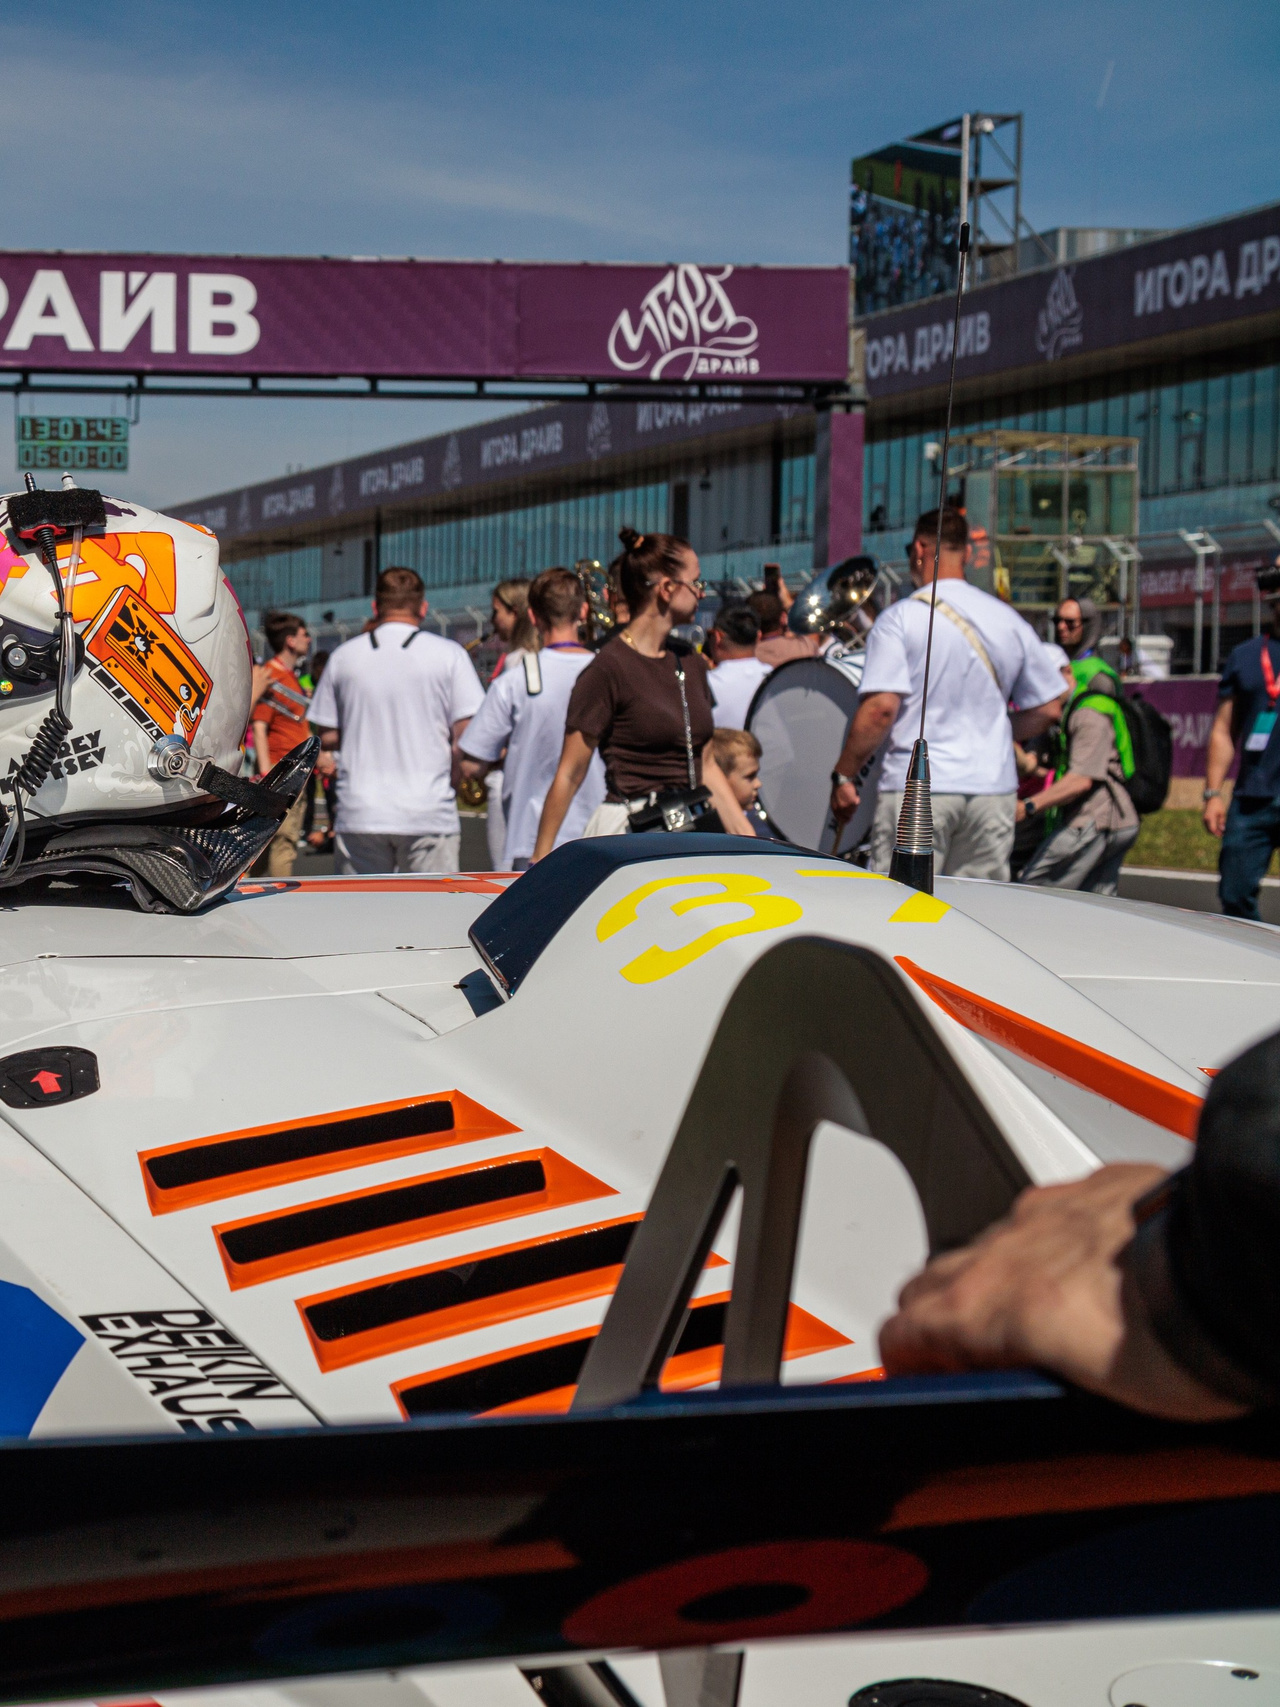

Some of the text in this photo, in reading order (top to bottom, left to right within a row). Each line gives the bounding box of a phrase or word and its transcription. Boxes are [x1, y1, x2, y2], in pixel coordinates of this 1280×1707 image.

[1134, 235, 1280, 317] ИГОРА ДР
[696, 357, 761, 375] ДРАЙВ
[866, 332, 909, 379] ОРА
[8, 730, 101, 775] AREY
